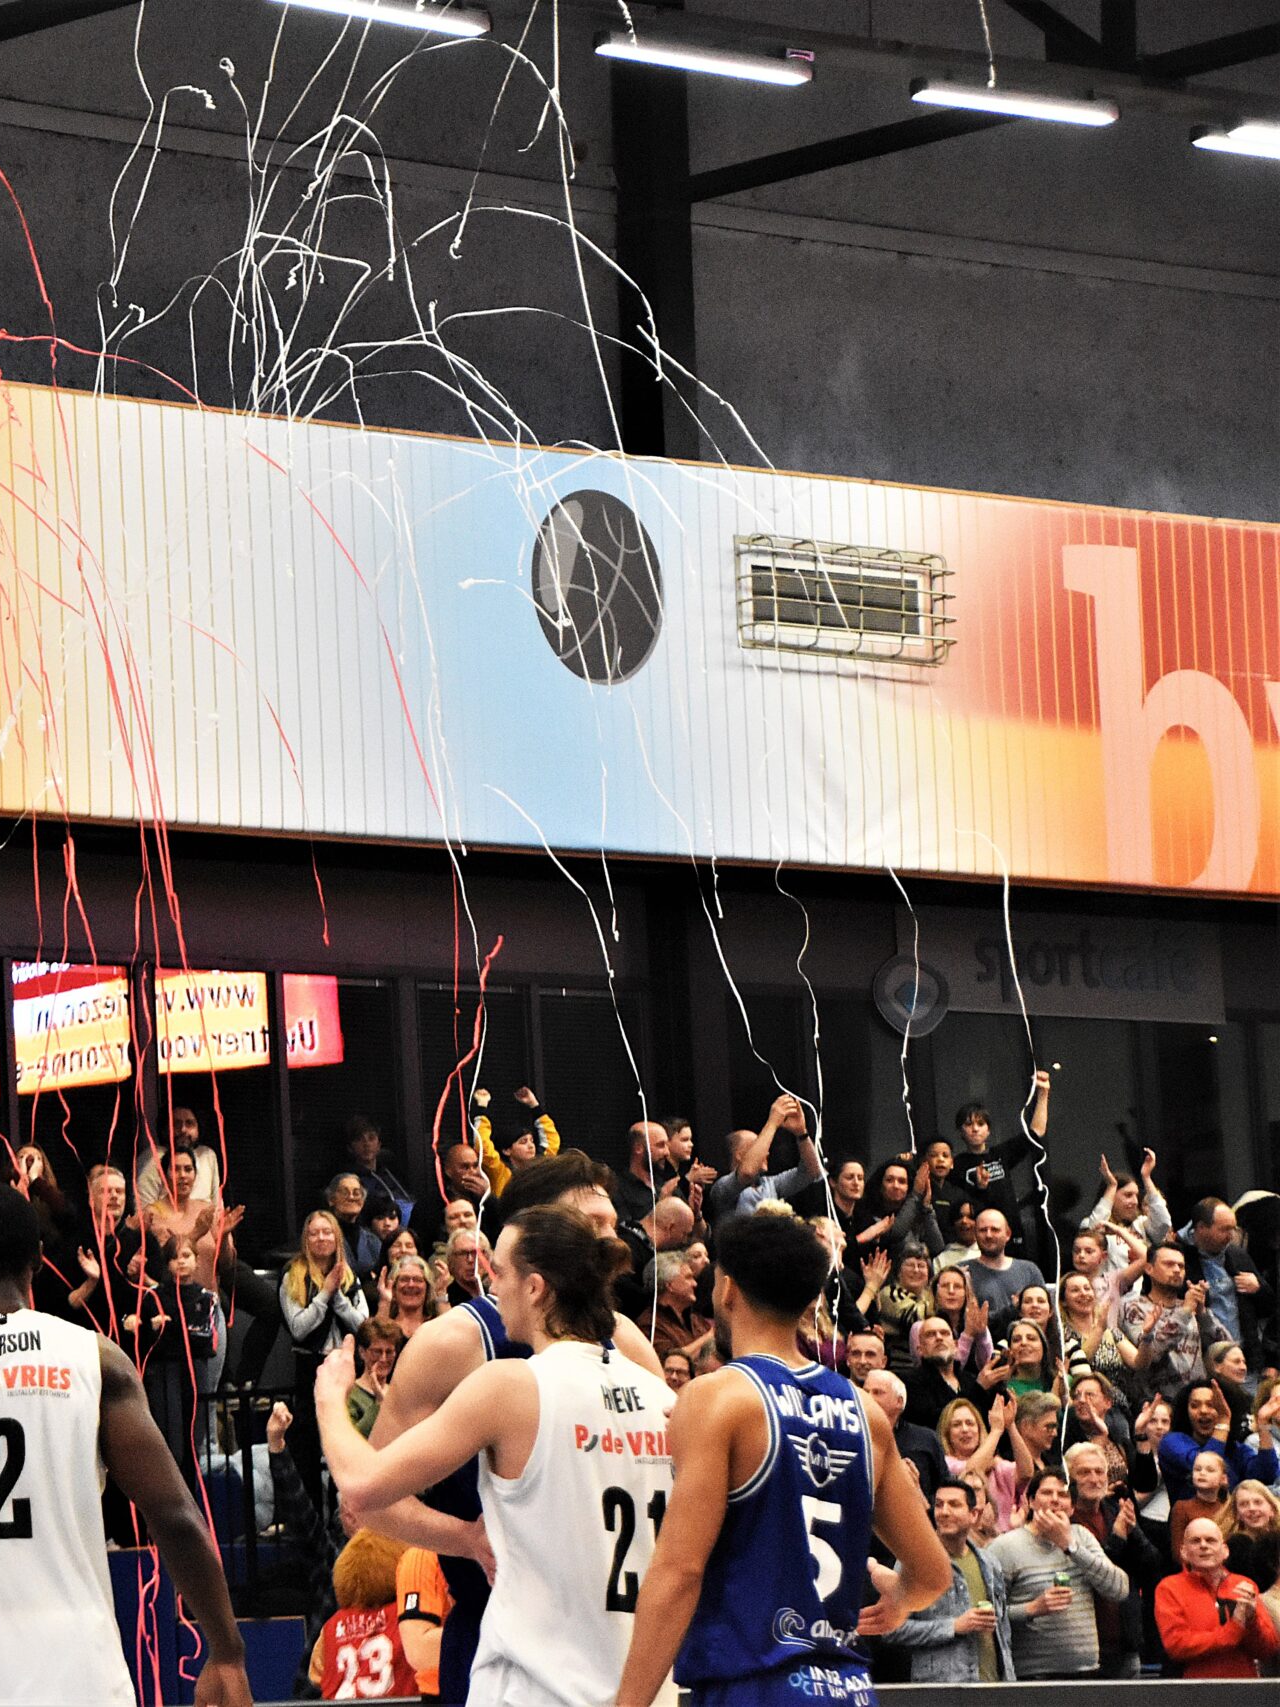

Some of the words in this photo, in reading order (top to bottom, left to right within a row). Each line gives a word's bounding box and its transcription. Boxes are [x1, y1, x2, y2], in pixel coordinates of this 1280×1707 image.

[1062, 544, 1280, 891] b
[3, 1365, 71, 1391] VRIES
[601, 1428, 624, 1454] de
[799, 1495, 843, 1602] 5
[334, 1633, 395, 1700] 23
